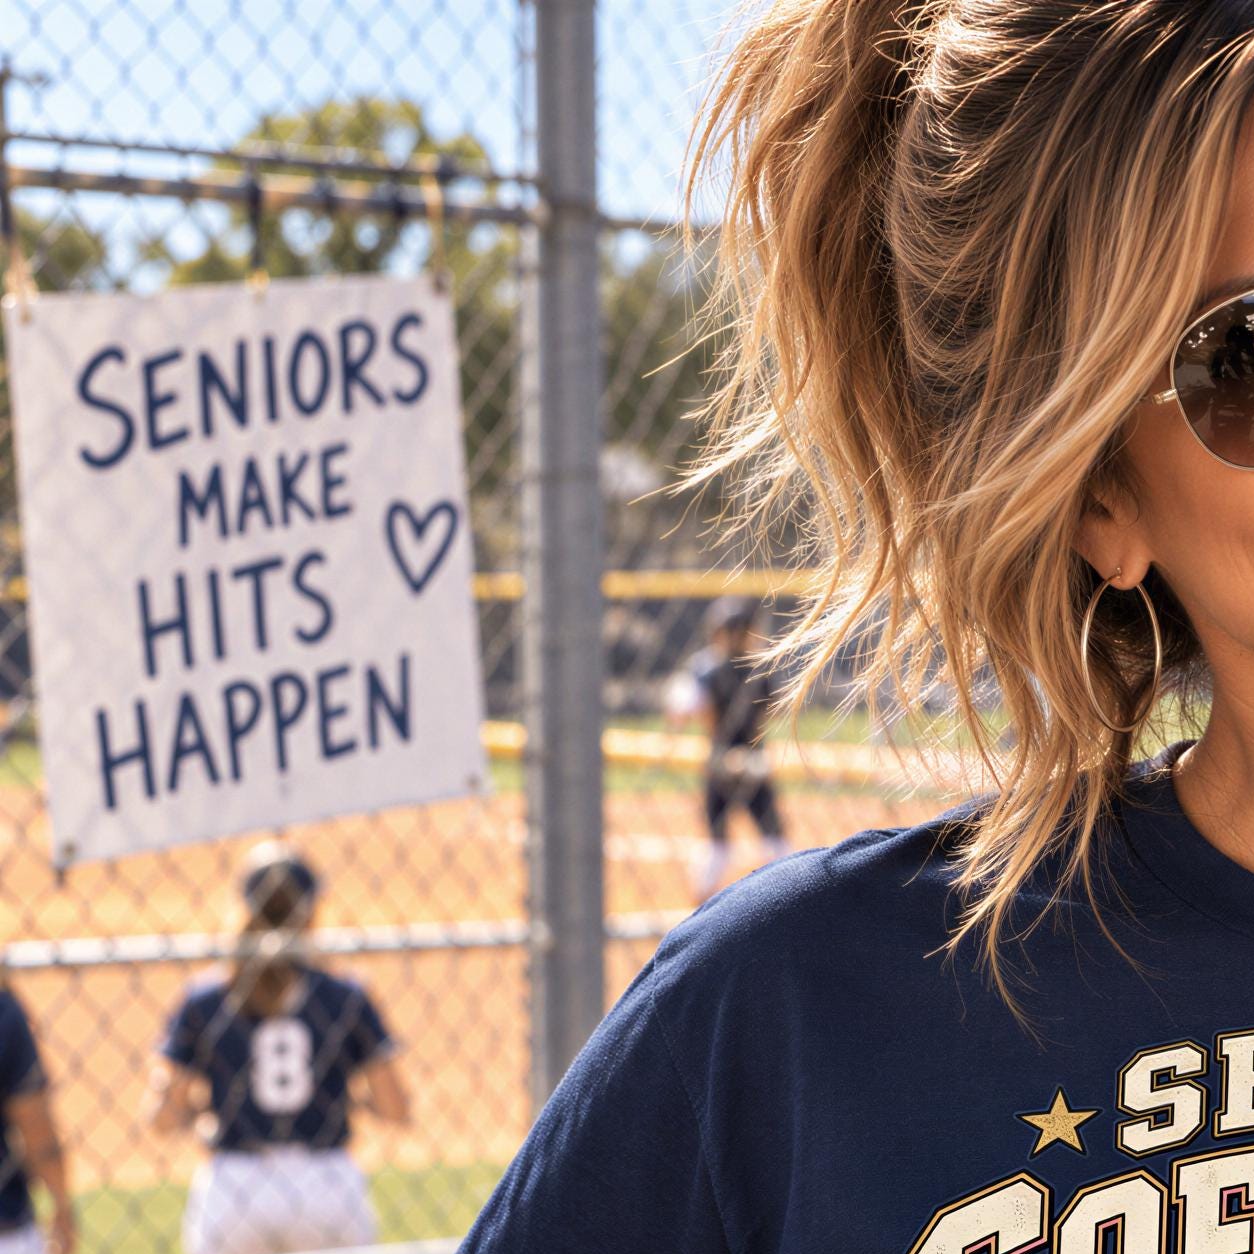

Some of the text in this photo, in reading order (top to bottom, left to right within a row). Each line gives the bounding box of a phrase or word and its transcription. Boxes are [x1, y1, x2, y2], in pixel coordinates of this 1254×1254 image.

[77, 312, 429, 470] SENIORS
[178, 443, 352, 547] MAKE
[138, 552, 334, 677] HITS
[96, 653, 411, 810] HAPPEN
[251, 1017, 314, 1114] 8
